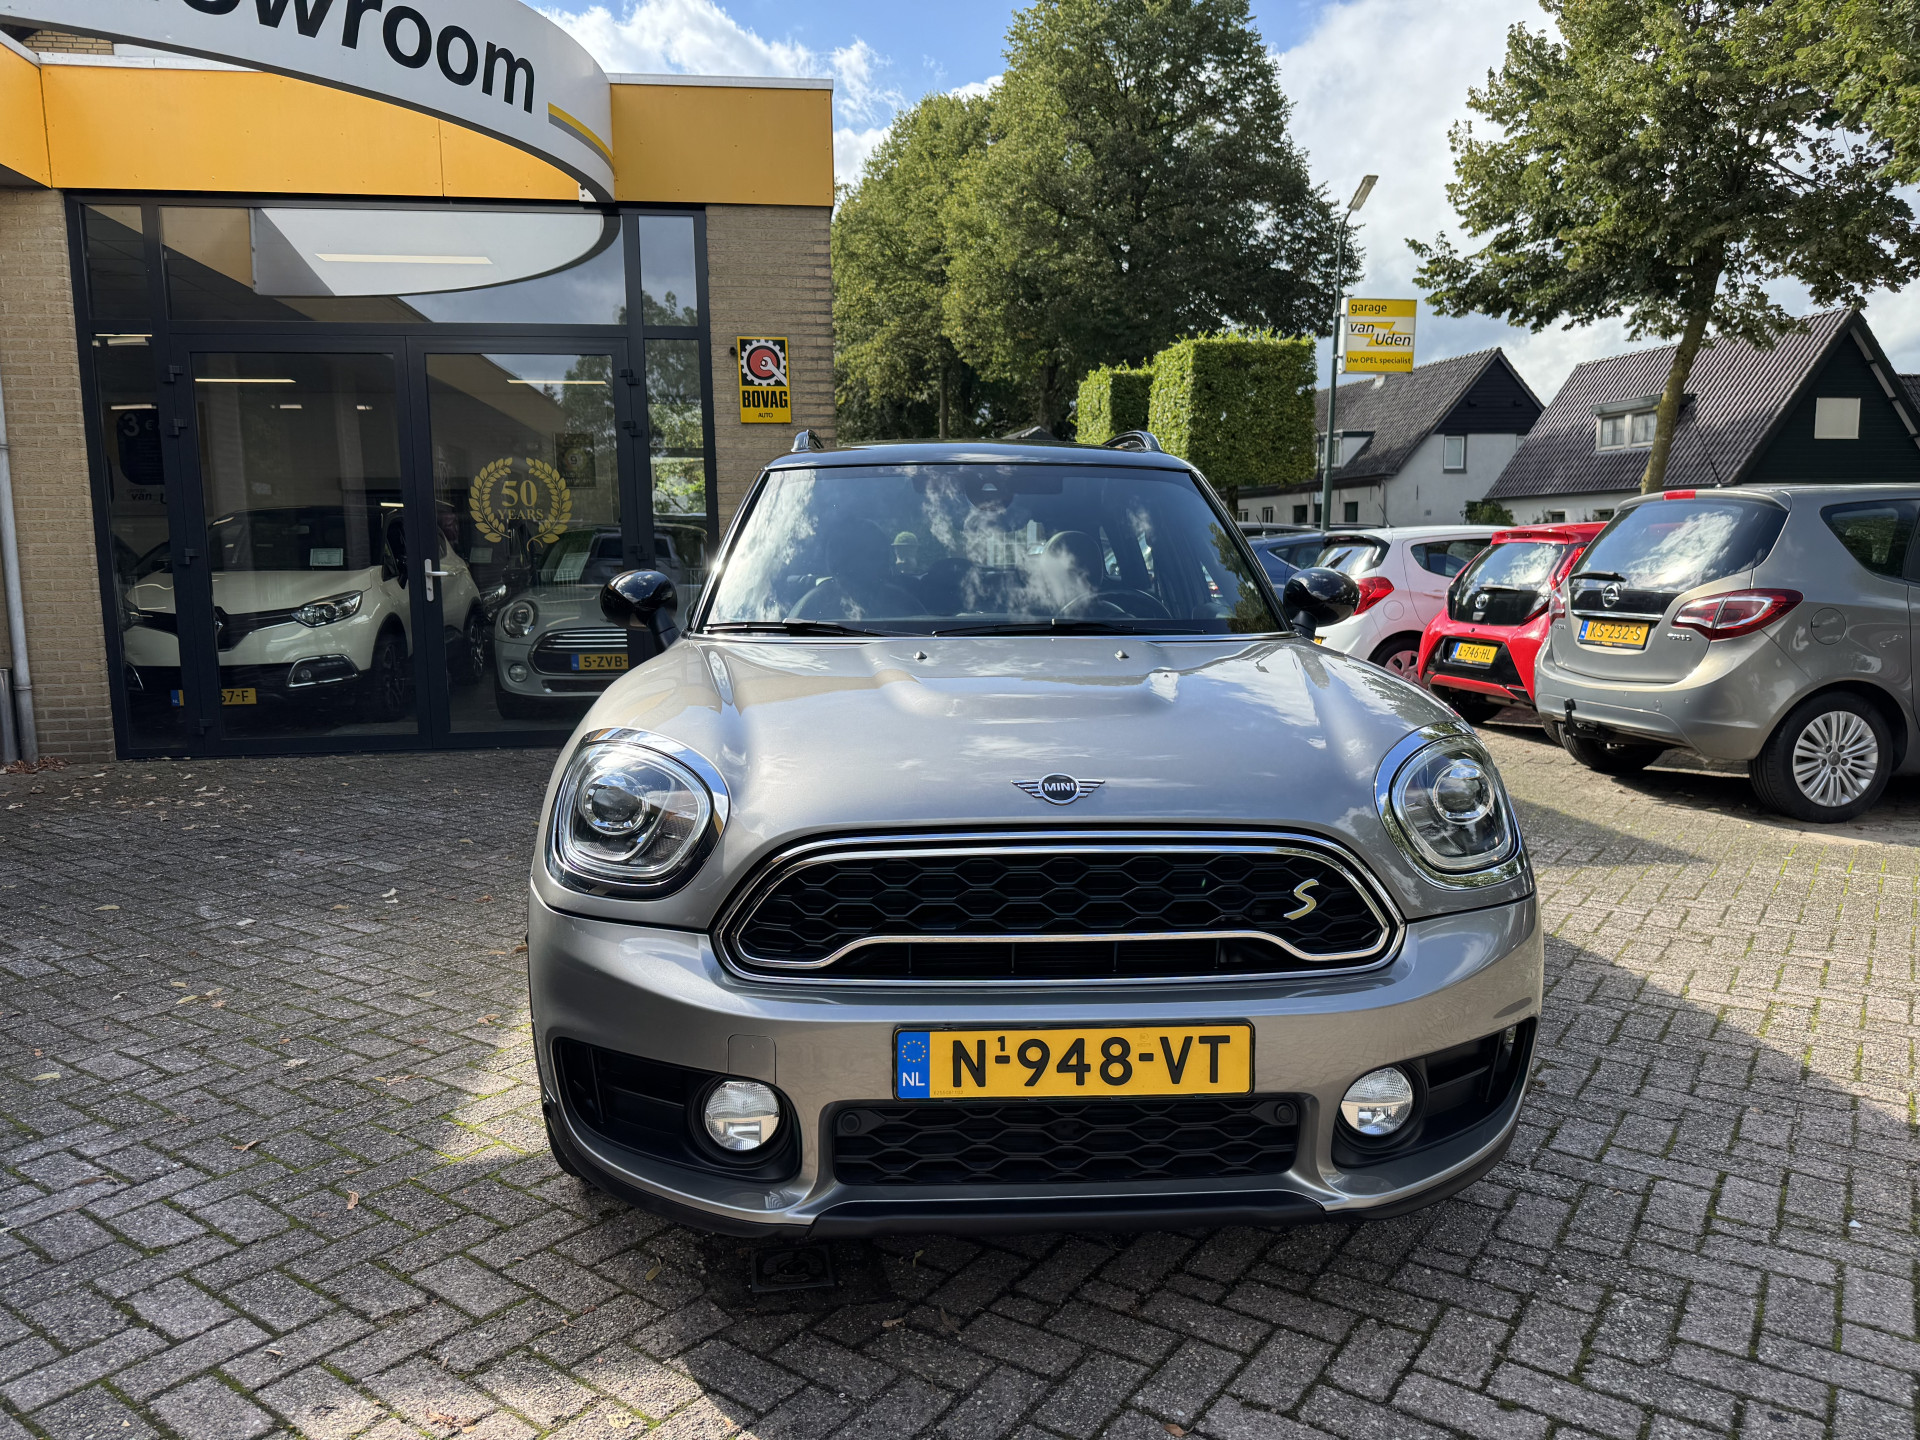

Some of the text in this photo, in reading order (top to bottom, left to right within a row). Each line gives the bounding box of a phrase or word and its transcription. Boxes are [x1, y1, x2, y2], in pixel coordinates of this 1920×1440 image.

[185, 0, 535, 114] wroom
[1351, 303, 1387, 314] garage
[1350, 323, 1374, 333] van
[1375, 333, 1411, 346] Uden
[1380, 357, 1411, 365] specialist
[742, 390, 788, 408] BOVAG
[501, 480, 538, 507] 50
[497, 509, 544, 520] YEARS
[1589, 622, 1643, 642] KS-232-S
[1458, 646, 1491, 660] L-746-HL
[1043, 782, 1075, 792] MINI
[1283, 878, 1319, 920] S
[902, 1071, 926, 1087] NL
